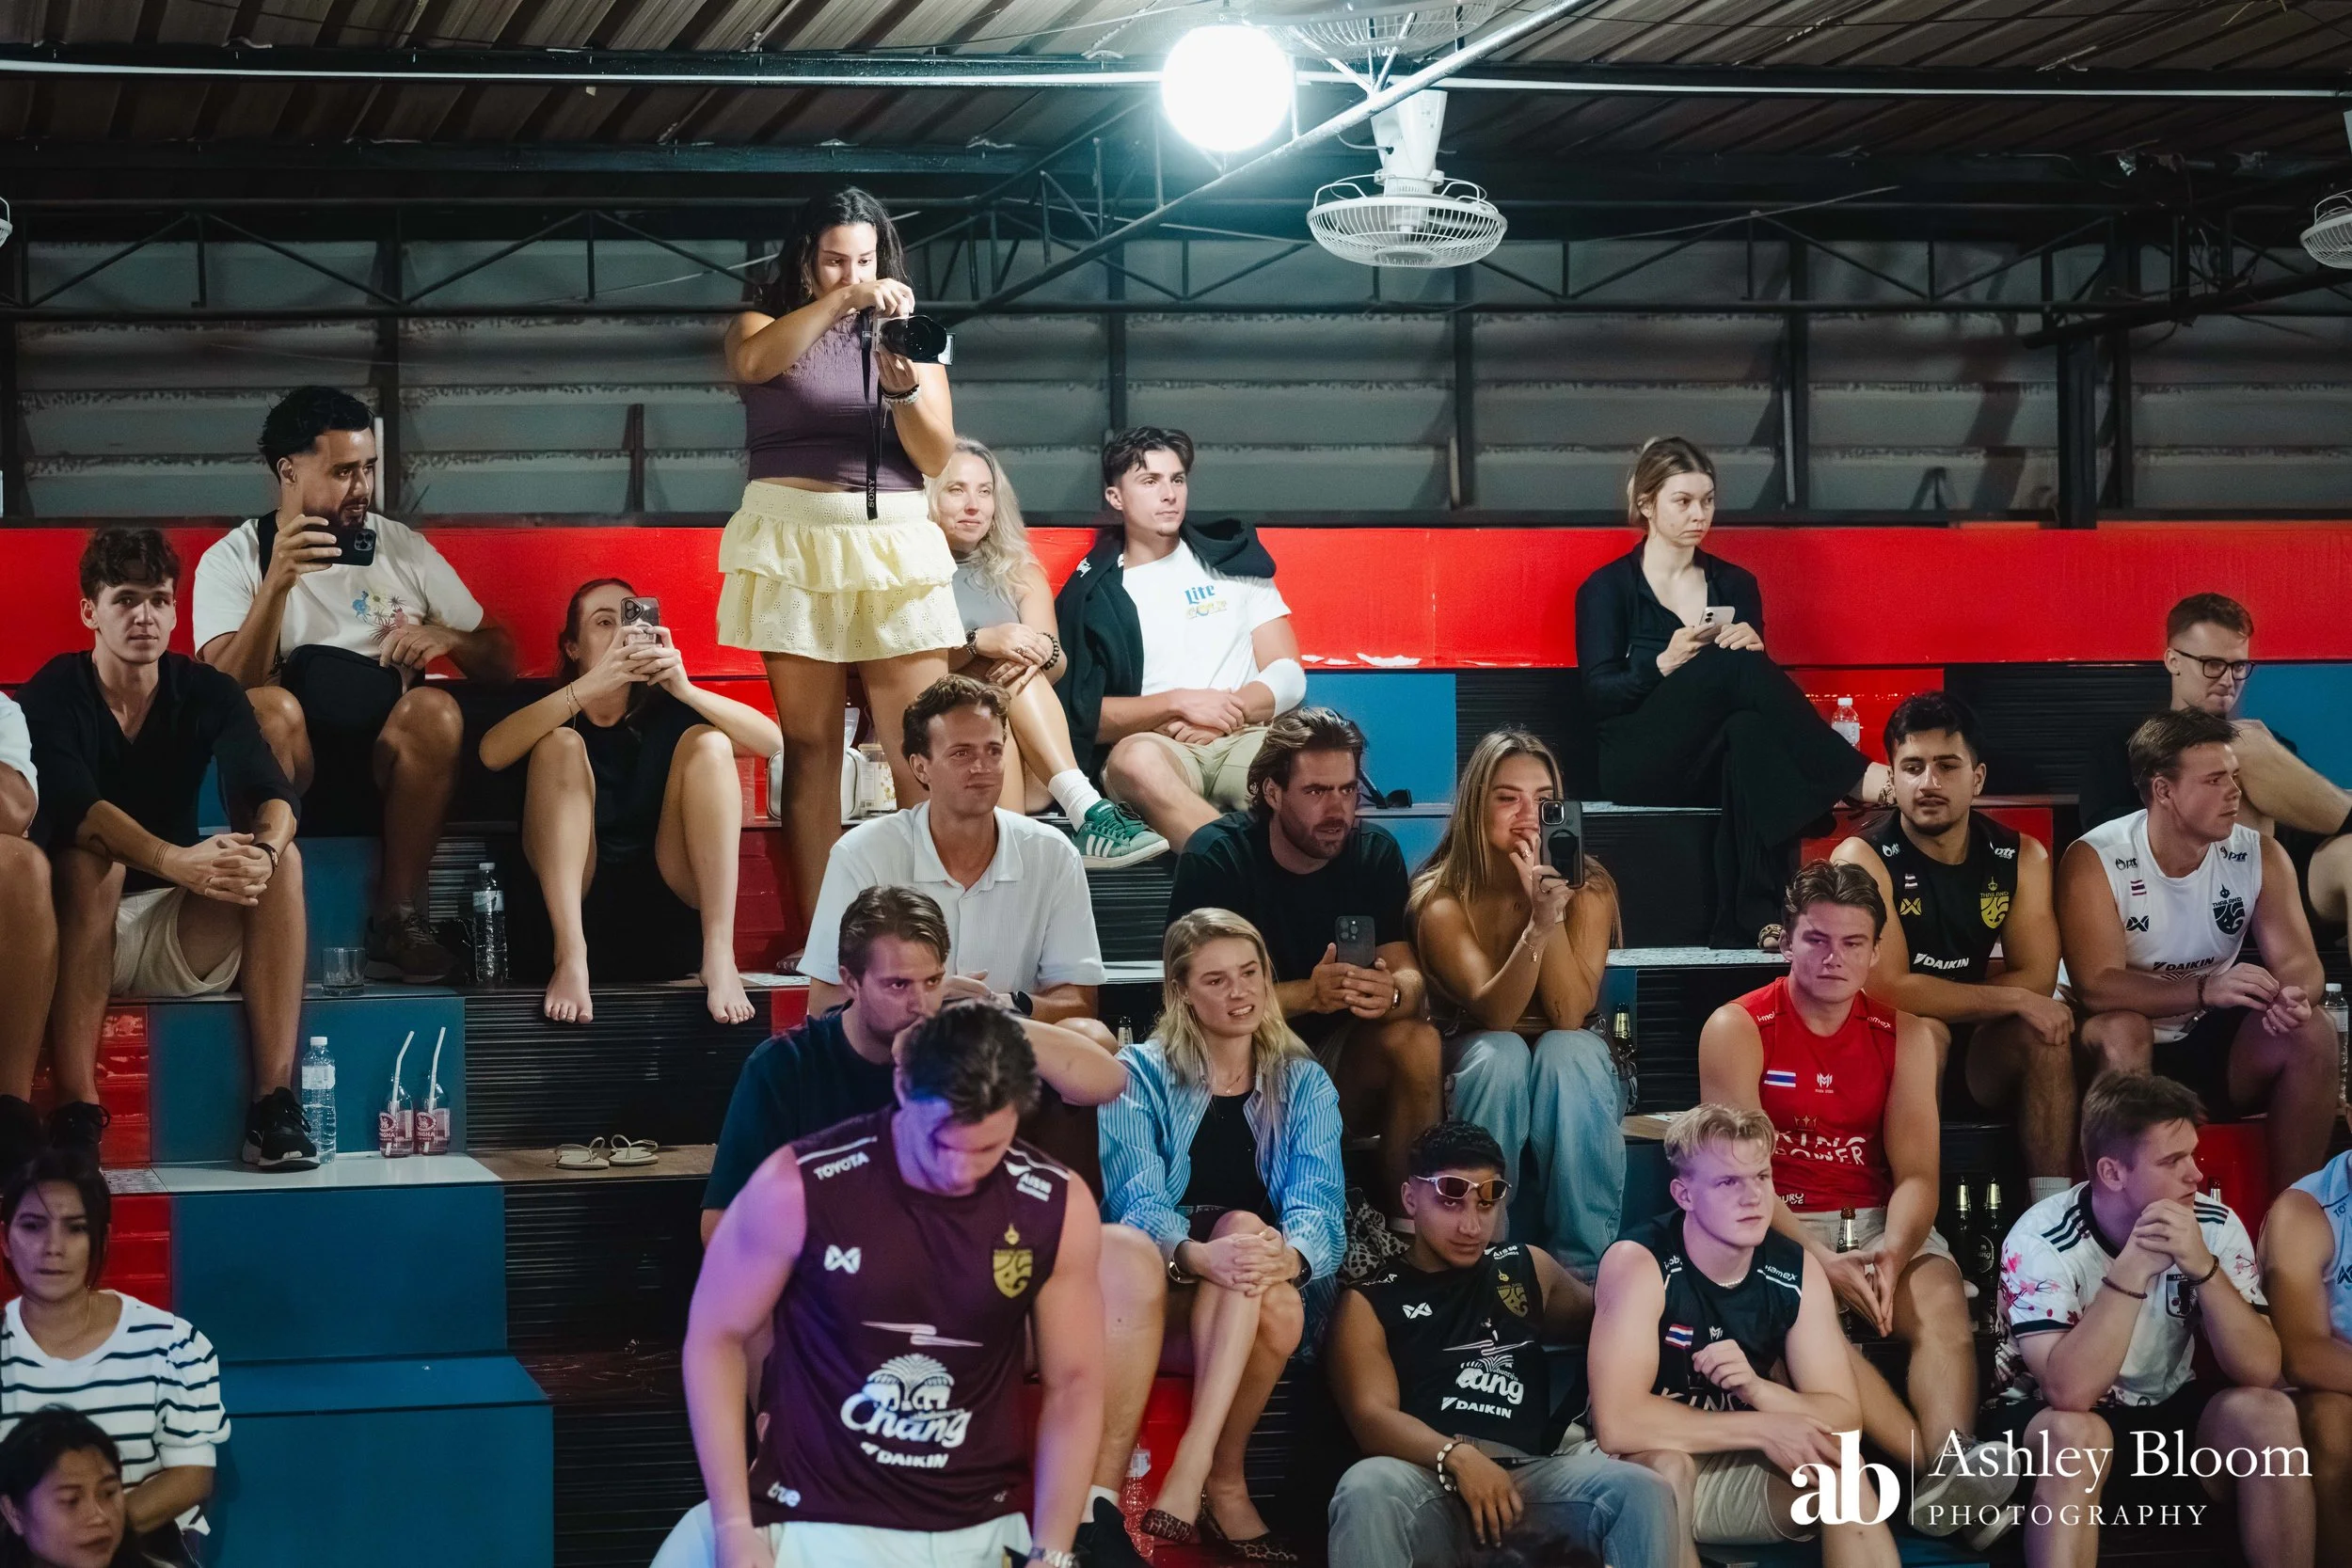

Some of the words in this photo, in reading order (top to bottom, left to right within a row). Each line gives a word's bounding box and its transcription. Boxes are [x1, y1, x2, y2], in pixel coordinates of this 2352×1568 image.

[1184, 585, 1215, 605] Lite
[1923, 956, 1970, 970] DAIKIN
[2165, 957, 2215, 971] DAIKIN
[813, 1150, 870, 1181] TOYOTA
[2333, 1202, 2348, 1218] TO
[1455, 1400, 1512, 1419] DAIKIN
[840, 1393, 974, 1449] Chang
[876, 1449, 949, 1469] DAIKIN
[767, 1481, 802, 1508] true
